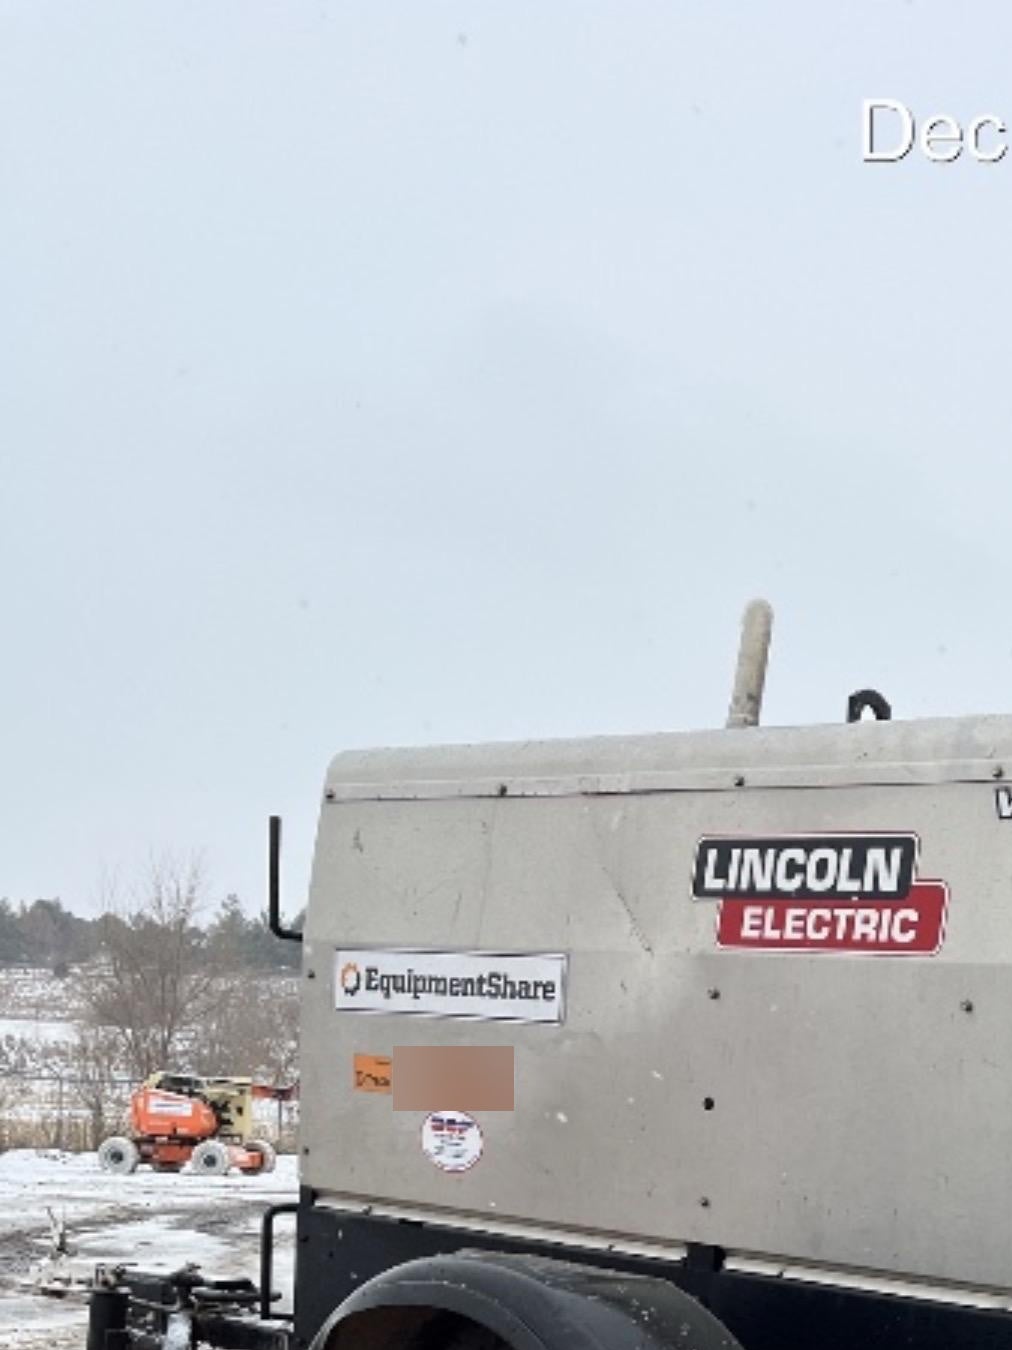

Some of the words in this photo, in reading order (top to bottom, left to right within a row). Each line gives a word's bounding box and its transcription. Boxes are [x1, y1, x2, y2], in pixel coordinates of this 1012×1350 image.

[703, 847, 903, 893] LINCOLN
[740, 905, 919, 944] ELECTRIC
[365, 965, 556, 1002] EquipmentShare
